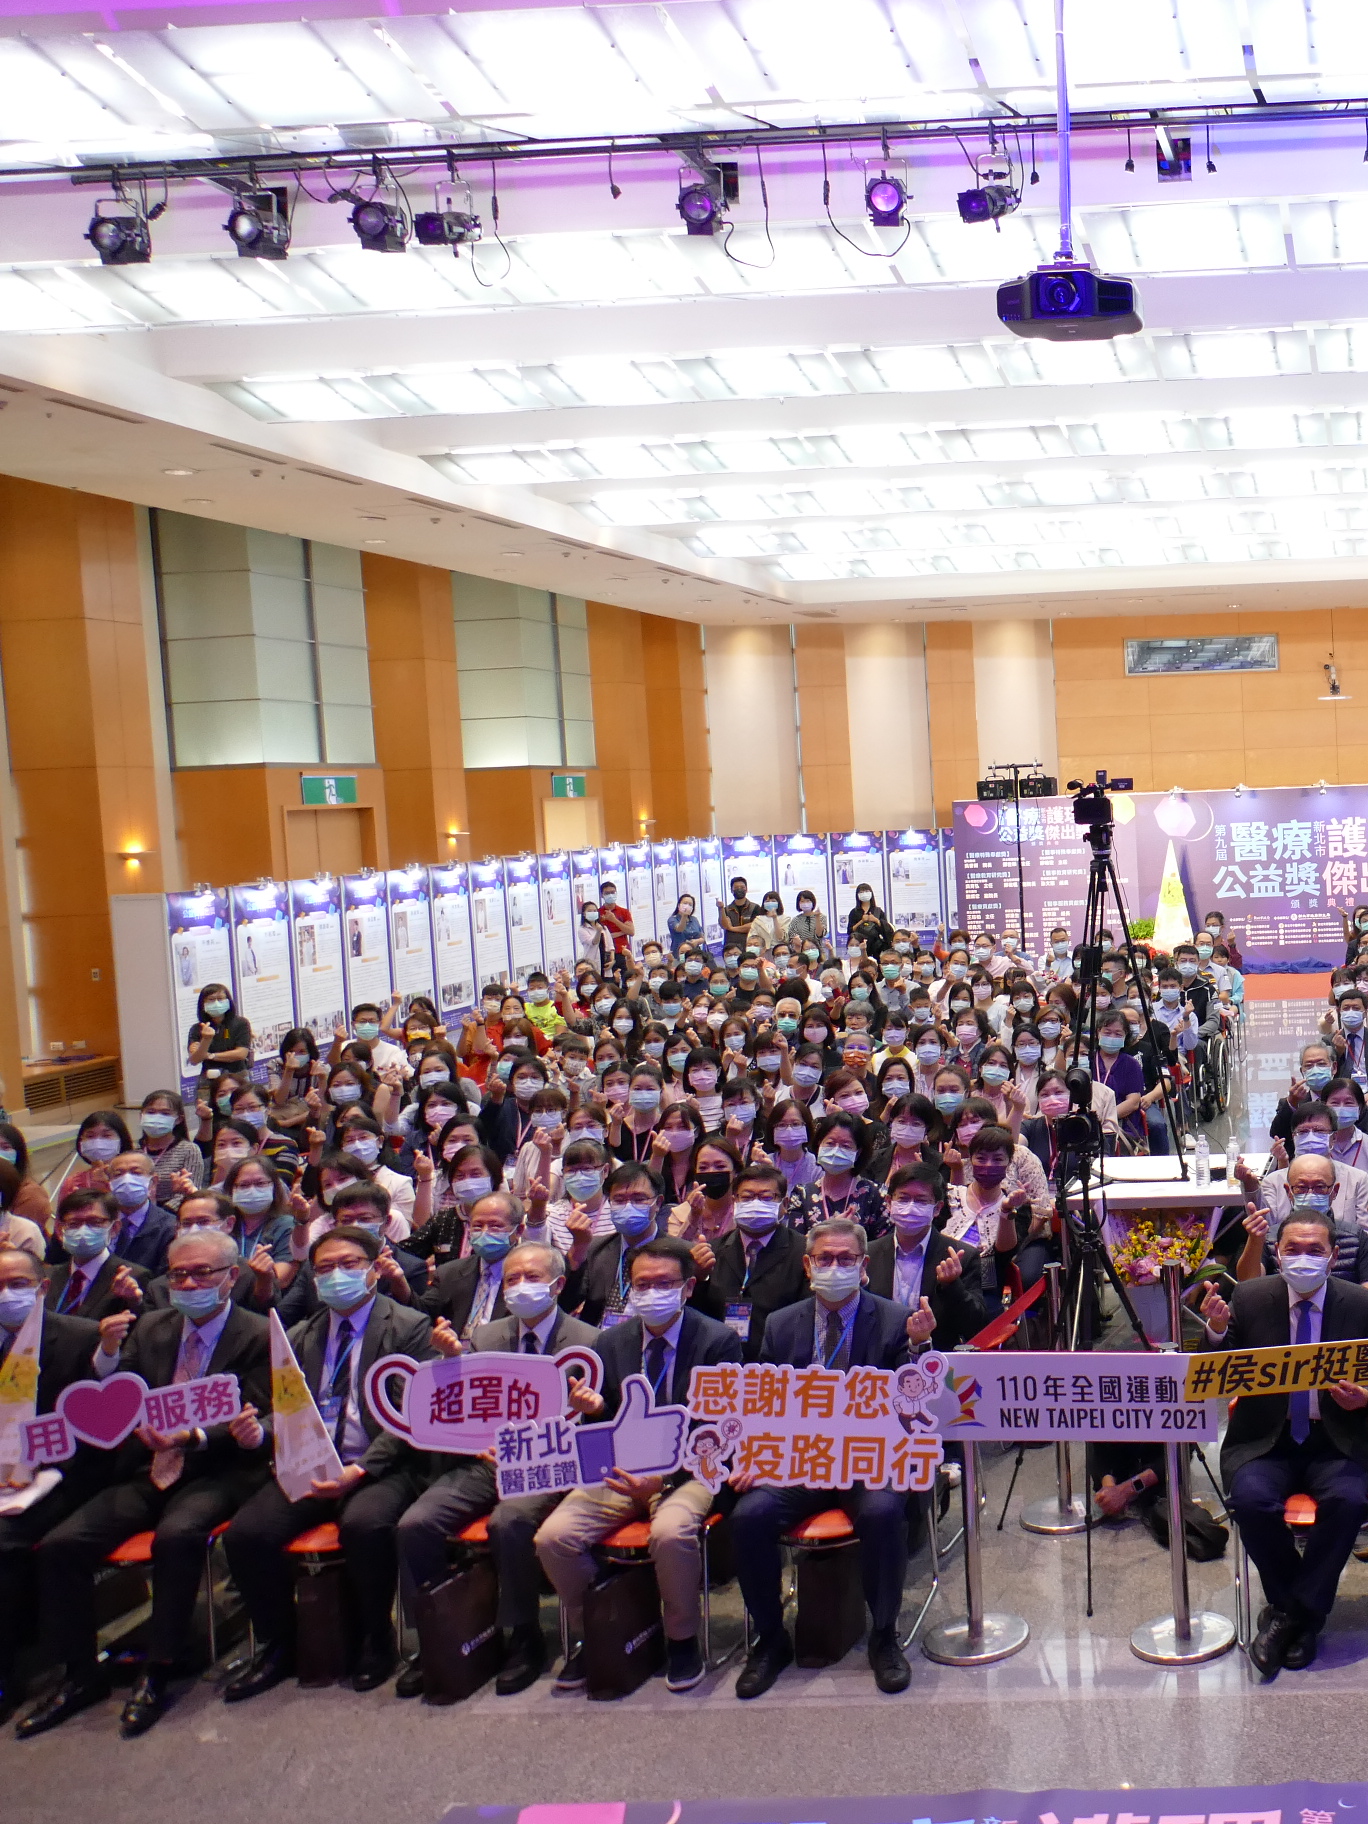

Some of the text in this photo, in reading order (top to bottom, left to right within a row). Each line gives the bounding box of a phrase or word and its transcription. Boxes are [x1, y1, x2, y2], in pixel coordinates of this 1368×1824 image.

[1215, 824, 1228, 861] 第九屆
[1230, 819, 1313, 862] 醫療
[1313, 820, 1326, 857] 新北市
[429, 1376, 541, 1425] 超罩的
[692, 1368, 891, 1419] 感謝有您
[996, 1375, 1206, 1404] 110年全國運動
[26, 1381, 235, 1462] 用 服務
[1000, 1408, 1207, 1430] NEW TAIPEI CITY 2021
[499, 1420, 573, 1464] 新北
[738, 1432, 939, 1485] 疫路同行
